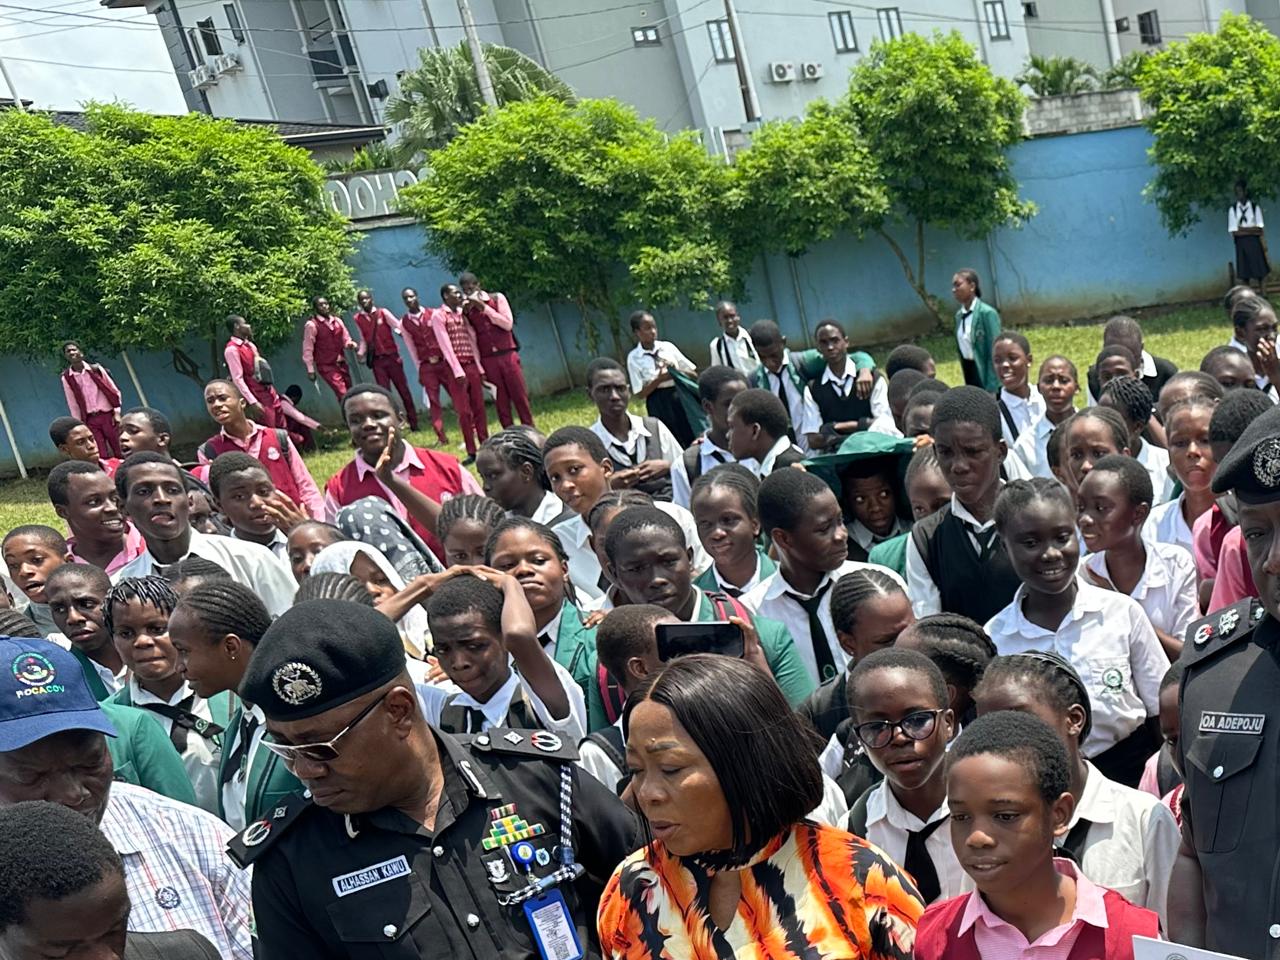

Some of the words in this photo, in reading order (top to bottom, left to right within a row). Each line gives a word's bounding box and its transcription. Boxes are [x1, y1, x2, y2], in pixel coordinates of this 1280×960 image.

[16, 685, 65, 699] POCACOV
[1202, 715, 1216, 728] OA
[1217, 716, 1262, 731] ADEPOJU
[341, 869, 380, 892] ALHASSAN
[381, 859, 405, 877] KAWU
